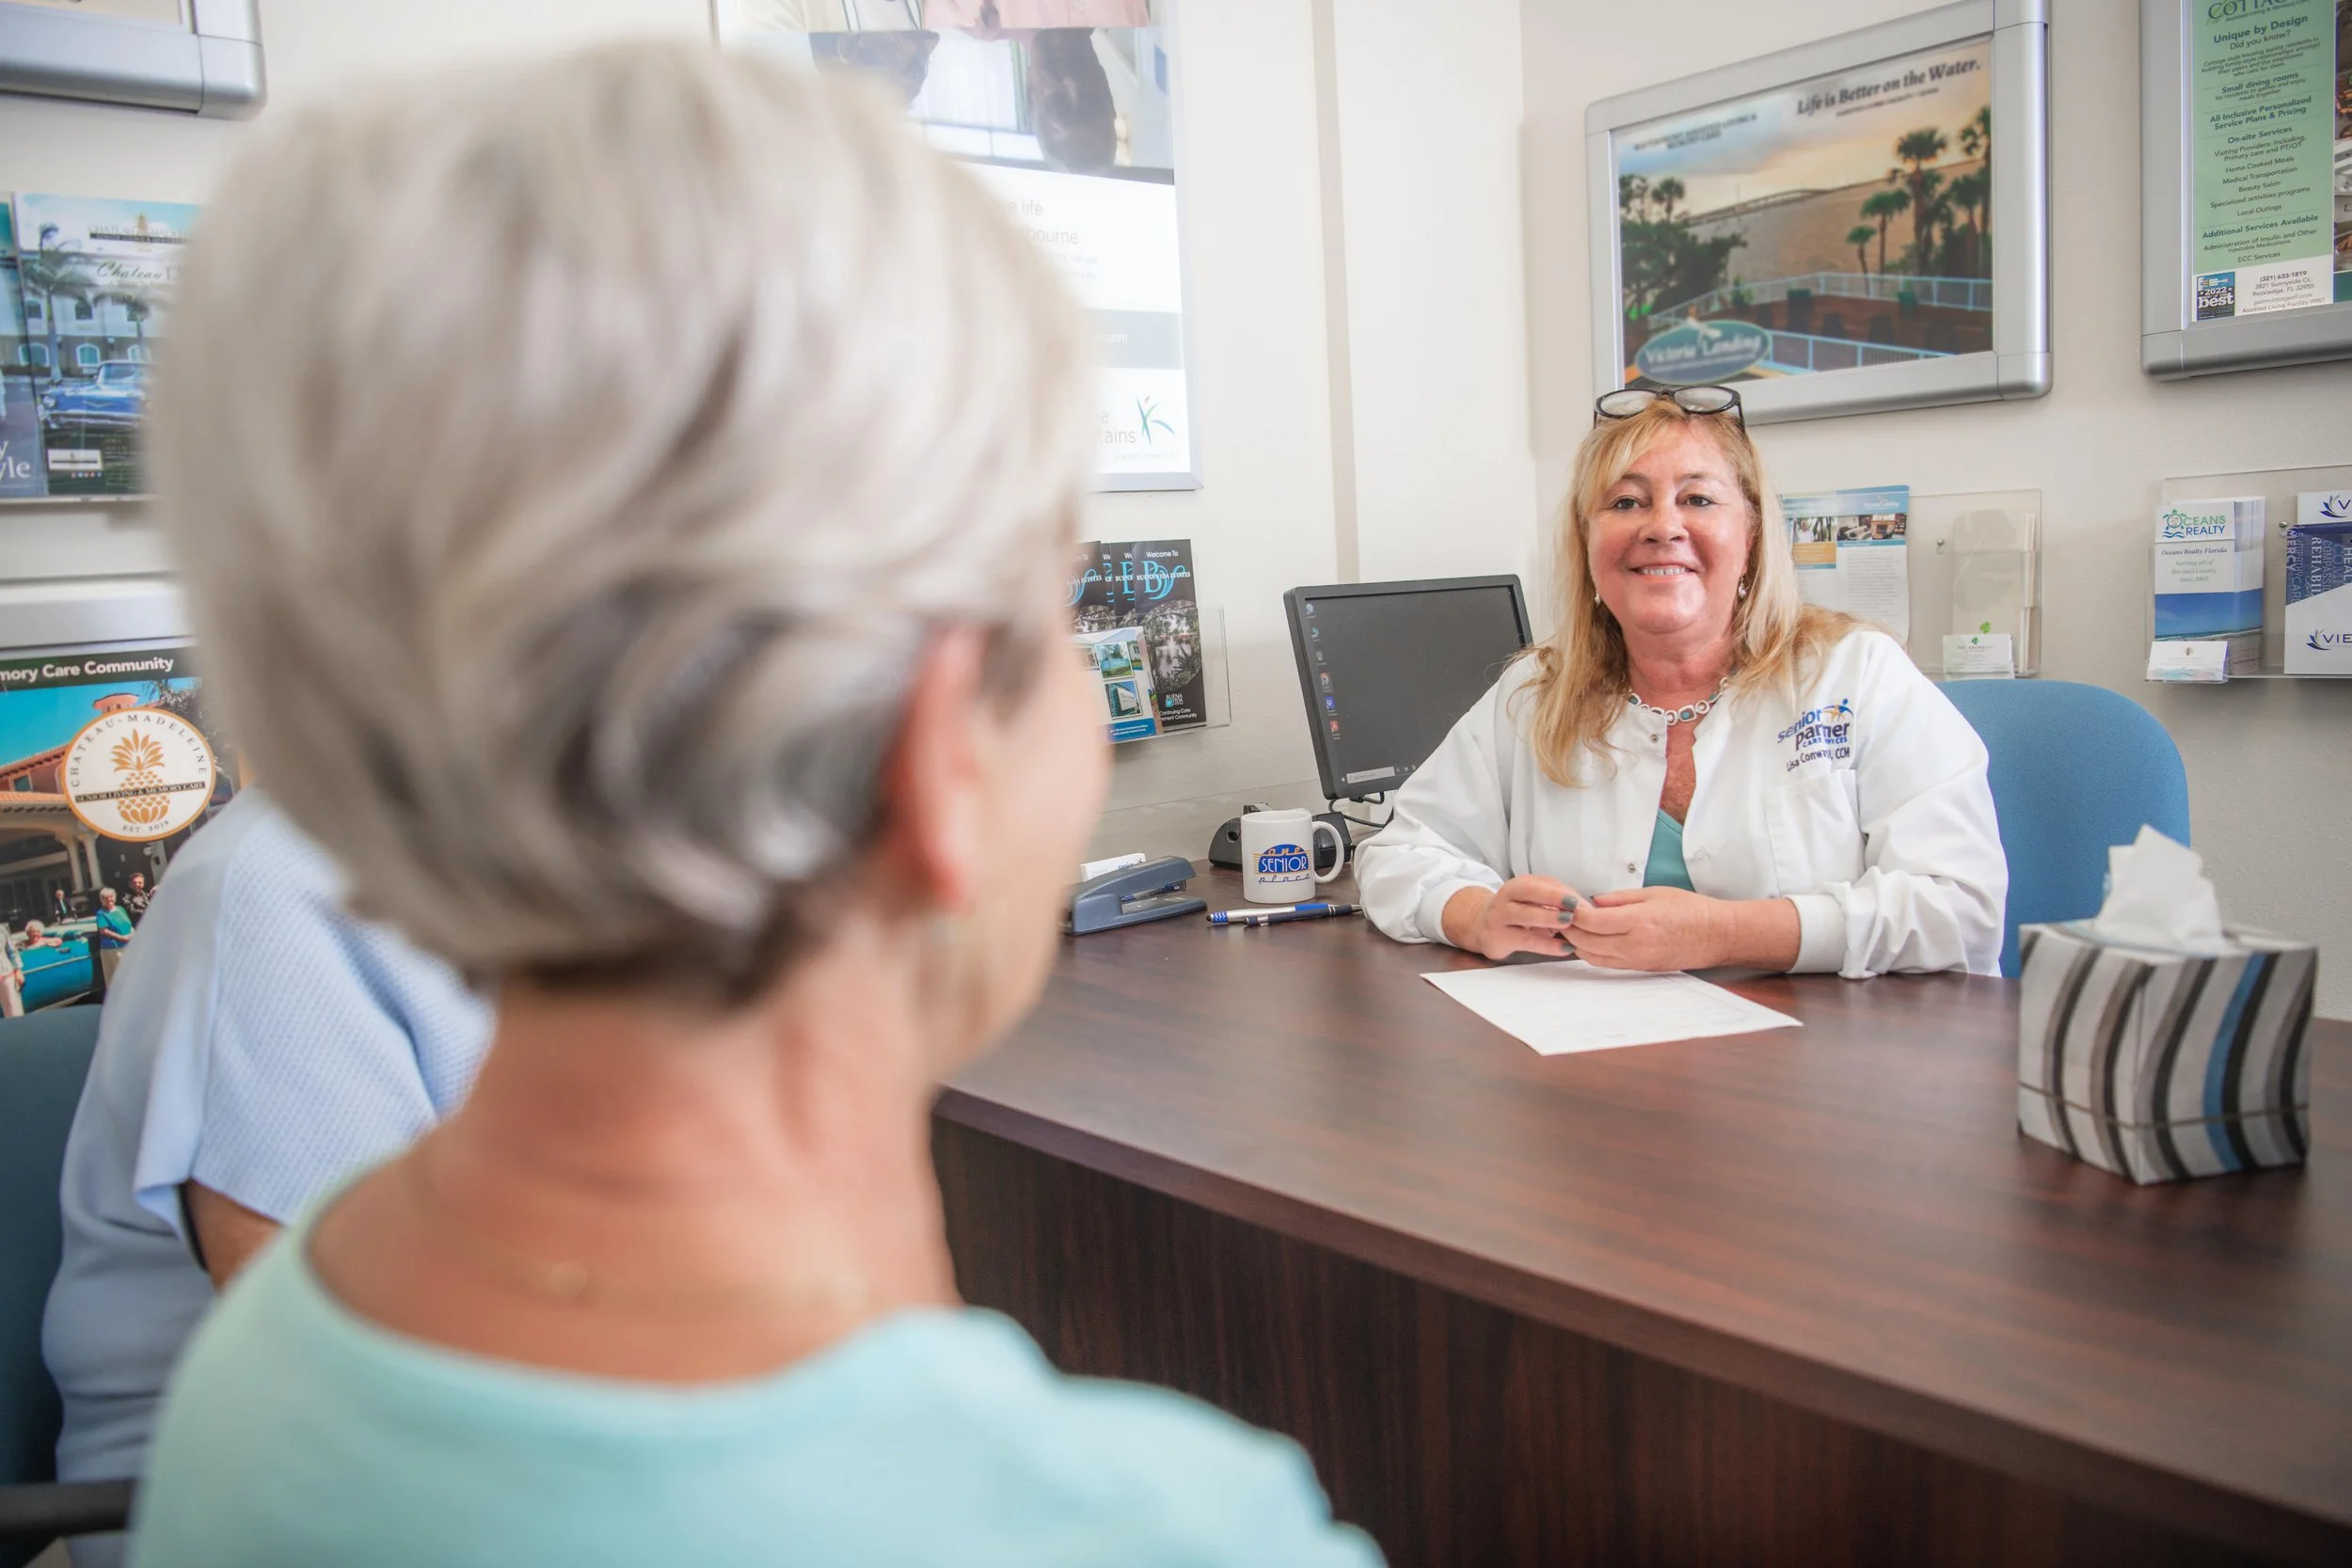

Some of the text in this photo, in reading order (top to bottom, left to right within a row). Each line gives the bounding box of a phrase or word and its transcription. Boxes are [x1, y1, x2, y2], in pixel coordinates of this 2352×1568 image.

[2214, 16, 2308, 43] Unique by Design
[2230, 30, 2291, 50] Did you know?
[1797, 96, 1822, 116] Life
[1825, 92, 1836, 106] is
[1838, 84, 1880, 103] Better
[1883, 79, 1900, 92] on
[1903, 71, 1925, 87] the
[1928, 59, 1980, 82] Water.
[2222, 73, 2298, 94] Small dining rooms
[2222, 108, 2257, 120] Inclusive
[2259, 96, 2312, 113] Personalized
[2215, 119, 2243, 130] Service
[2246, 115, 2266, 123] Plans
[2278, 106, 2307, 118] Pricing
[2228, 127, 2293, 144] On-site Services
[2215, 149, 2237, 157] Visiting
[2224, 153, 2249, 162] Primary
[2280, 142, 2302, 151] PT/OT
[2248, 160, 2273, 169] Cooked
[2275, 155, 2294, 165] Meals
[2223, 166, 2297, 184] Medical Transportation
[2211, 186, 2311, 209] Specialized activities programs
[1022, 198, 1043, 216] life
[2256, 204, 2281, 214] Outings
[2202, 214, 2319, 239] Additional Services Available
[2203, 240, 2250, 251] Administration
[2296, 229, 2317, 237] Other
[2256, 240, 2291, 249] Medications
[97, 261, 163, 279] Chateau
[2259, 270, 2307, 283] (321) 633-1819
[2204, 286, 2227, 295] 2022
[2270, 279, 2301, 288] Sunnyside
[2198, 293, 2233, 309] best
[1645, 344, 1695, 363] Victoria
[1702, 334, 1760, 356] Landing
[2185, 525, 2225, 535] REALTY
[2287, 530, 2296, 572] MERCY
[2296, 532, 2304, 577] SYMPATHY
[2323, 634, 2352, 643] VIE
[42, 664, 80, 678] Care
[85, 657, 173, 674] Community
[1777, 709, 1821, 744] senior
[71, 714, 207, 787] CHATEAU MADELEINE
[1787, 759, 1799, 771] Lisa
[76, 793, 106, 802] SENIOR
[108, 790, 137, 800] LIVING
[146, 784, 181, 796] MEMORY
[1268, 847, 1301, 857] one
[1262, 856, 1307, 873] SENIOR
[1258, 874, 1310, 885] place
